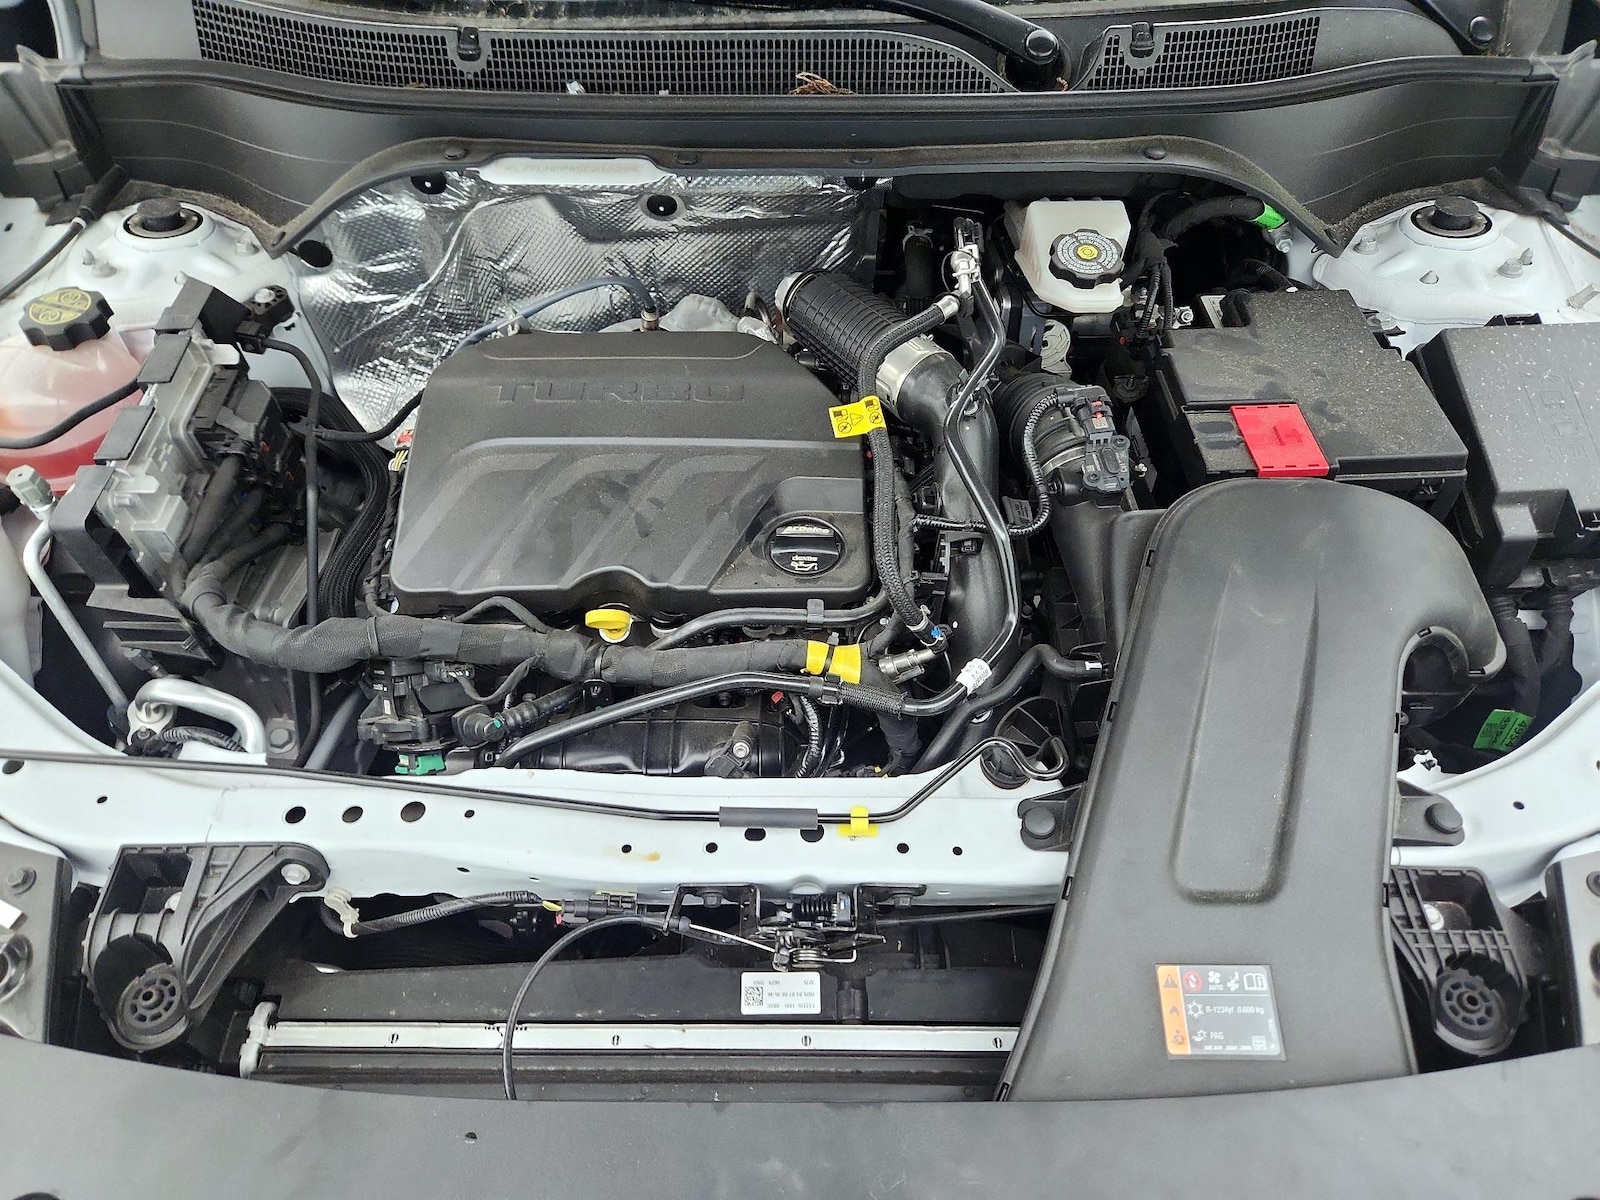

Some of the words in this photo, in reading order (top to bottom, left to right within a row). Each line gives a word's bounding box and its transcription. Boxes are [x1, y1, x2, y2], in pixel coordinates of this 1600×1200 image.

[482, 382, 747, 403] TURBO
[782, 526, 830, 534] ACDelco
[1206, 1005, 1234, 1016] R-1234yf
[1210, 1032, 1224, 1040] PAG
